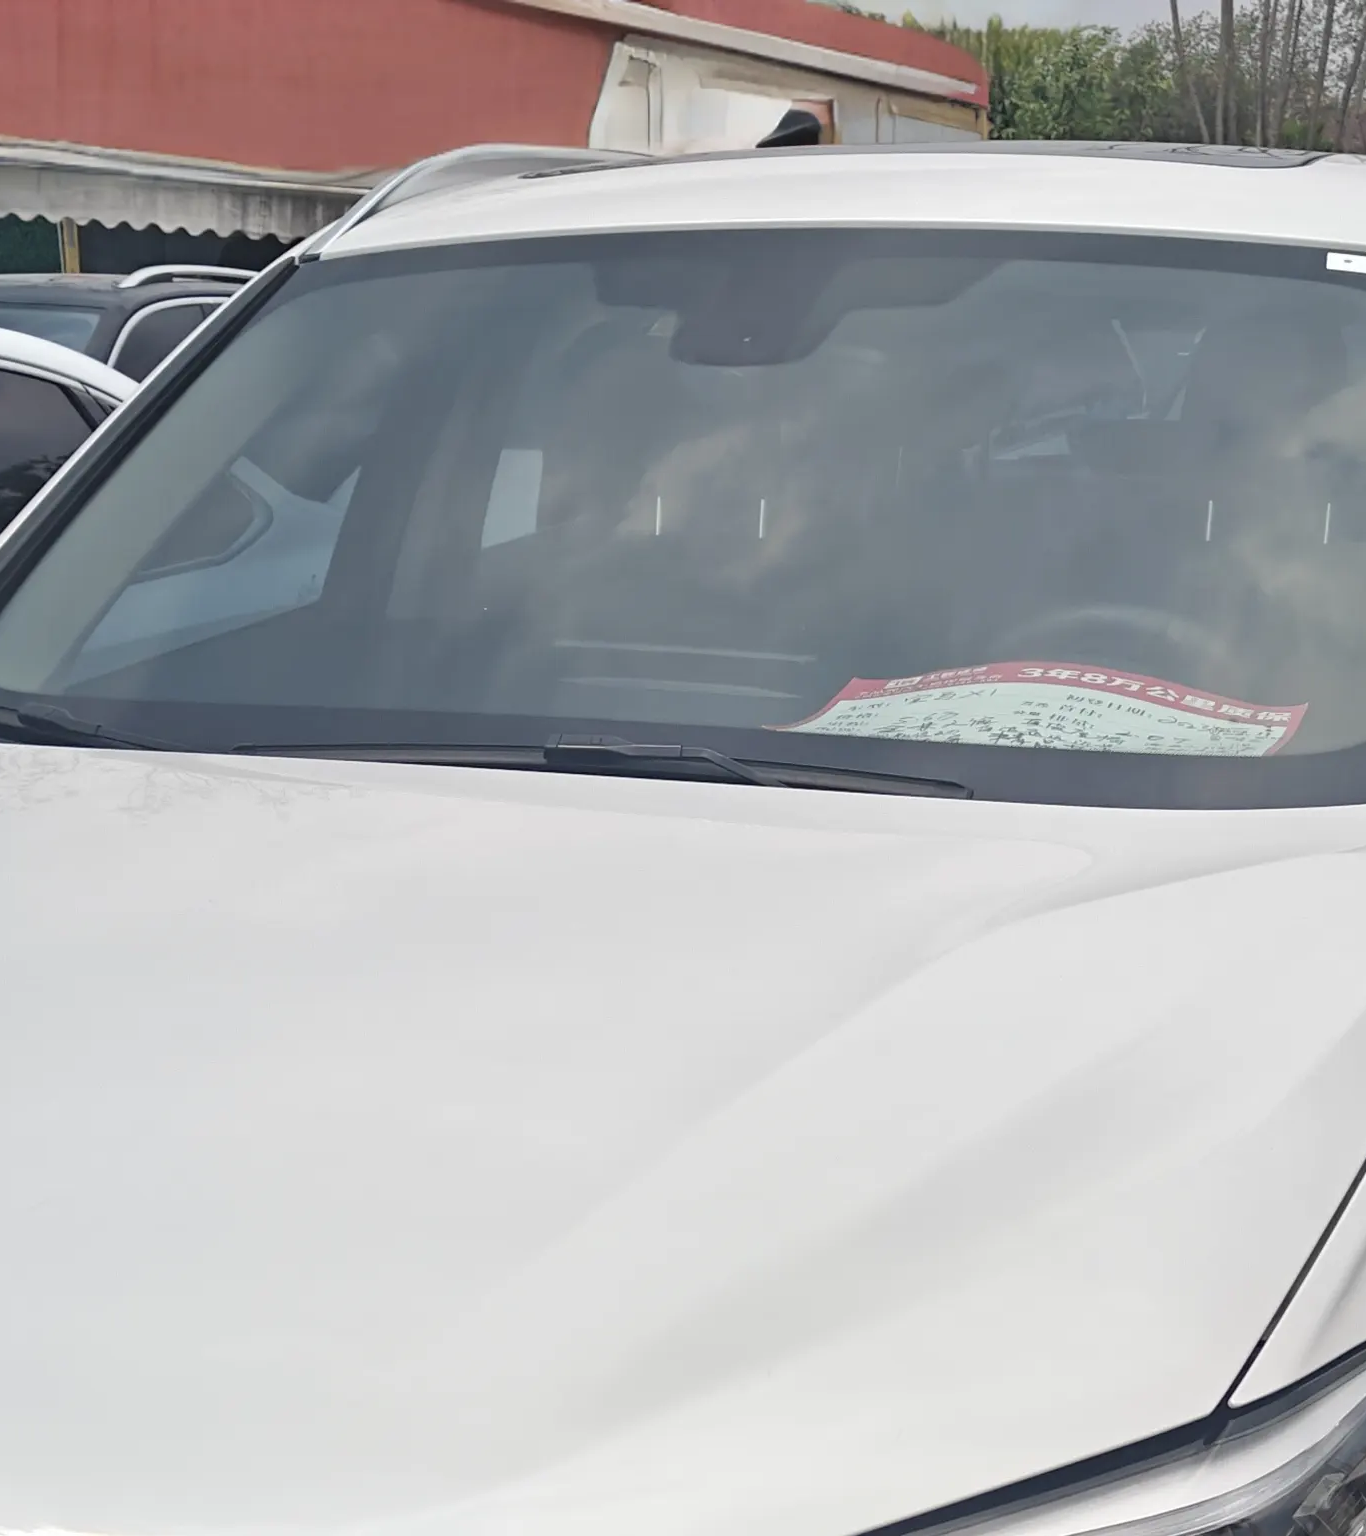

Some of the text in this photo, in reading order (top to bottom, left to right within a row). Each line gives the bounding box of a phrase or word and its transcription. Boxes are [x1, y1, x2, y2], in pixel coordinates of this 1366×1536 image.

[1017, 667, 1292, 722] 3年8万公里质保
